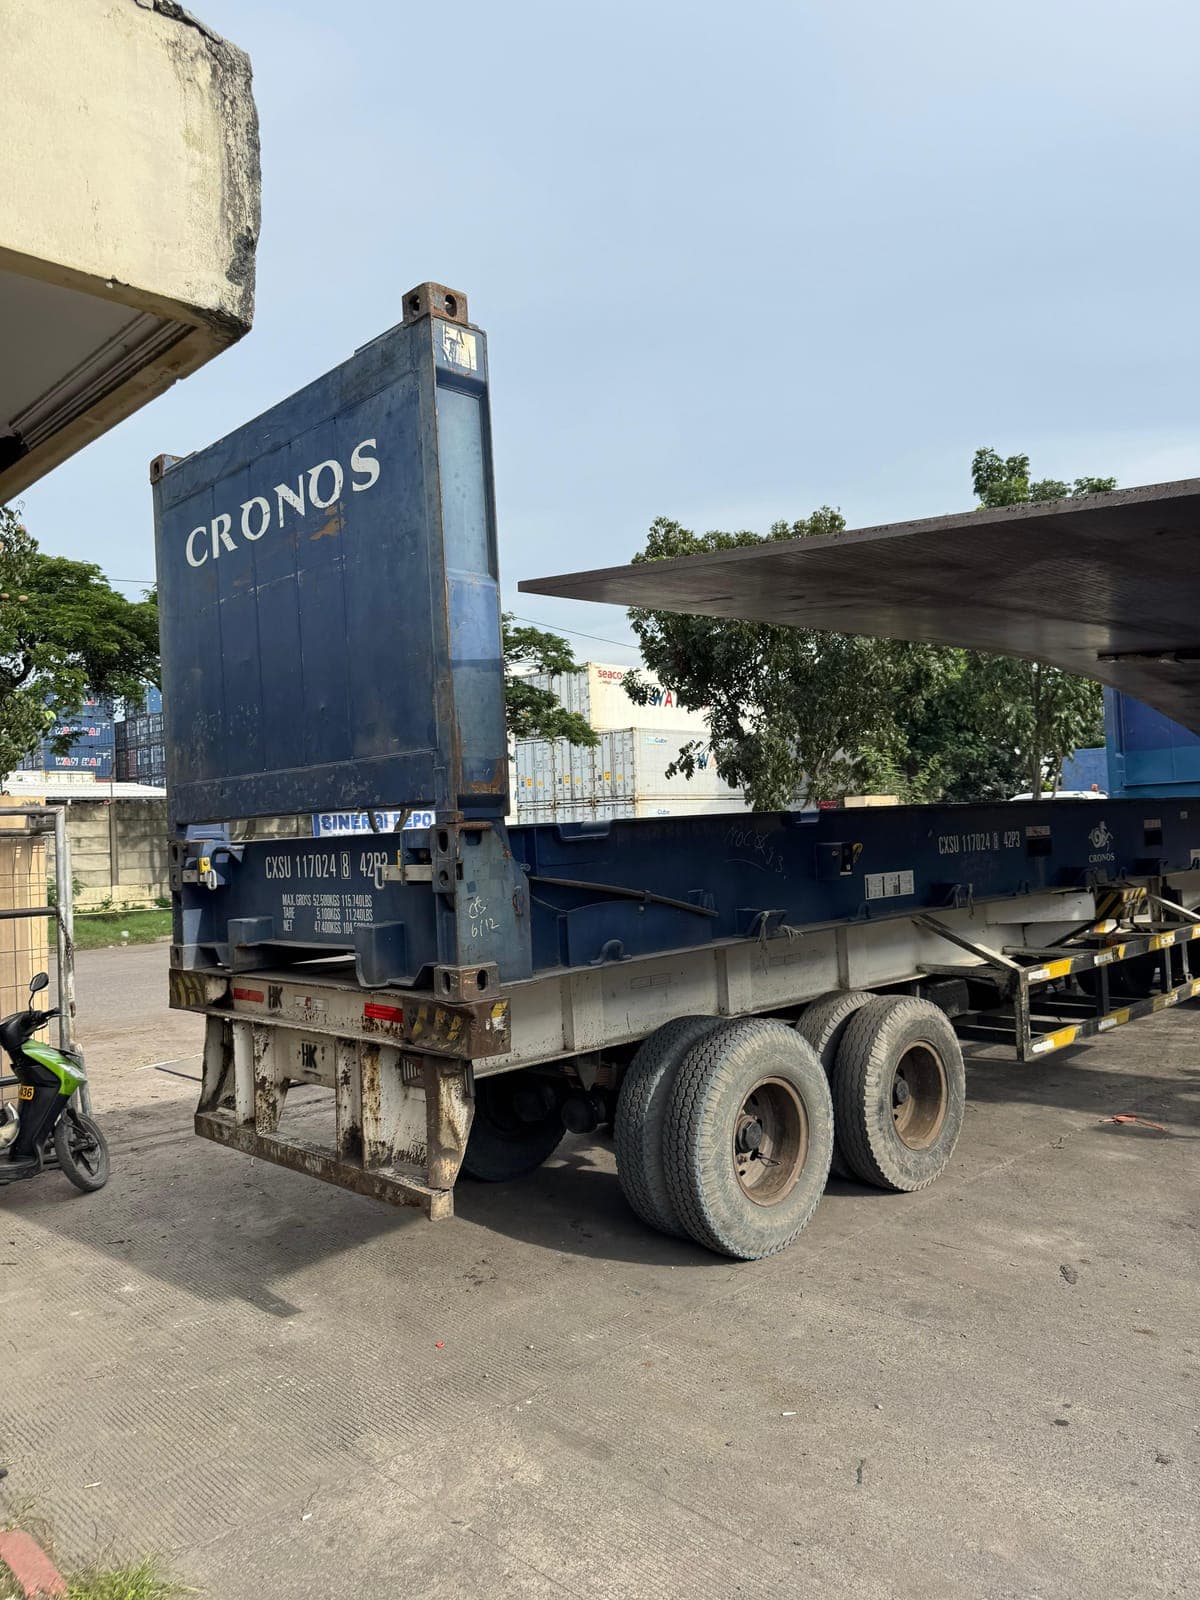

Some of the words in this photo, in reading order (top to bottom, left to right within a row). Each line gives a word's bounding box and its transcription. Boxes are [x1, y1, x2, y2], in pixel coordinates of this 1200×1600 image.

[185, 438, 381, 567] CRONOS
[597, 669, 623, 680] seaco
[938, 835, 960, 855] CXSU
[962, 833, 991, 852] 117024
[1003, 831, 1021, 848] 42P3
[1089, 852, 1115, 863] CRONOS
[265, 855, 292, 879] CXSU
[296, 853, 337, 878] 117024
[341, 852, 351, 878] 8
[282, 906, 296, 919] TARE
[282, 919, 293, 932] NET
